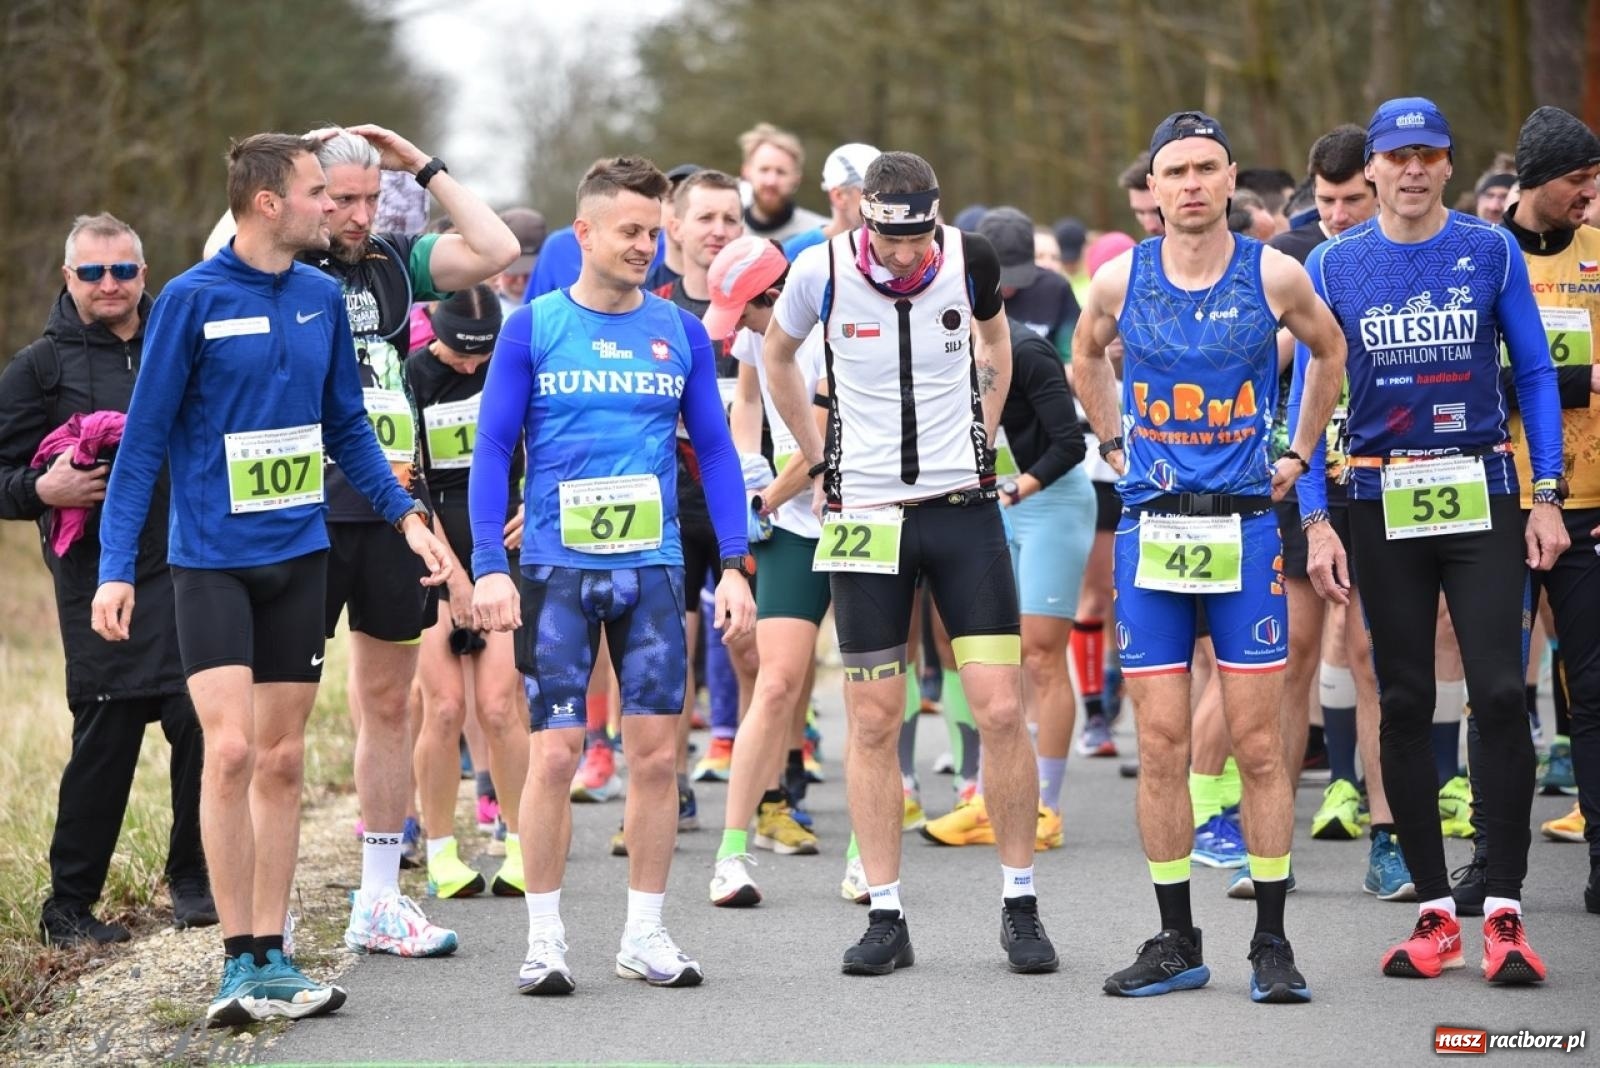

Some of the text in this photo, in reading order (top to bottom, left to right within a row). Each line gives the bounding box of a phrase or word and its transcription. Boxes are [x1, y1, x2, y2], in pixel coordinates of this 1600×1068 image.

[1364, 313, 1474, 347] SILESIAN
[1371, 345, 1472, 367] TRIATHLON TEAM
[538, 370, 685, 399] RUNNERS
[1133, 380, 1257, 427] FORMA
[248, 455, 310, 496] 107
[1413, 486, 1460, 522] 53
[591, 504, 636, 539] 67
[830, 525, 871, 558] 22
[1165, 545, 1212, 578] 42
